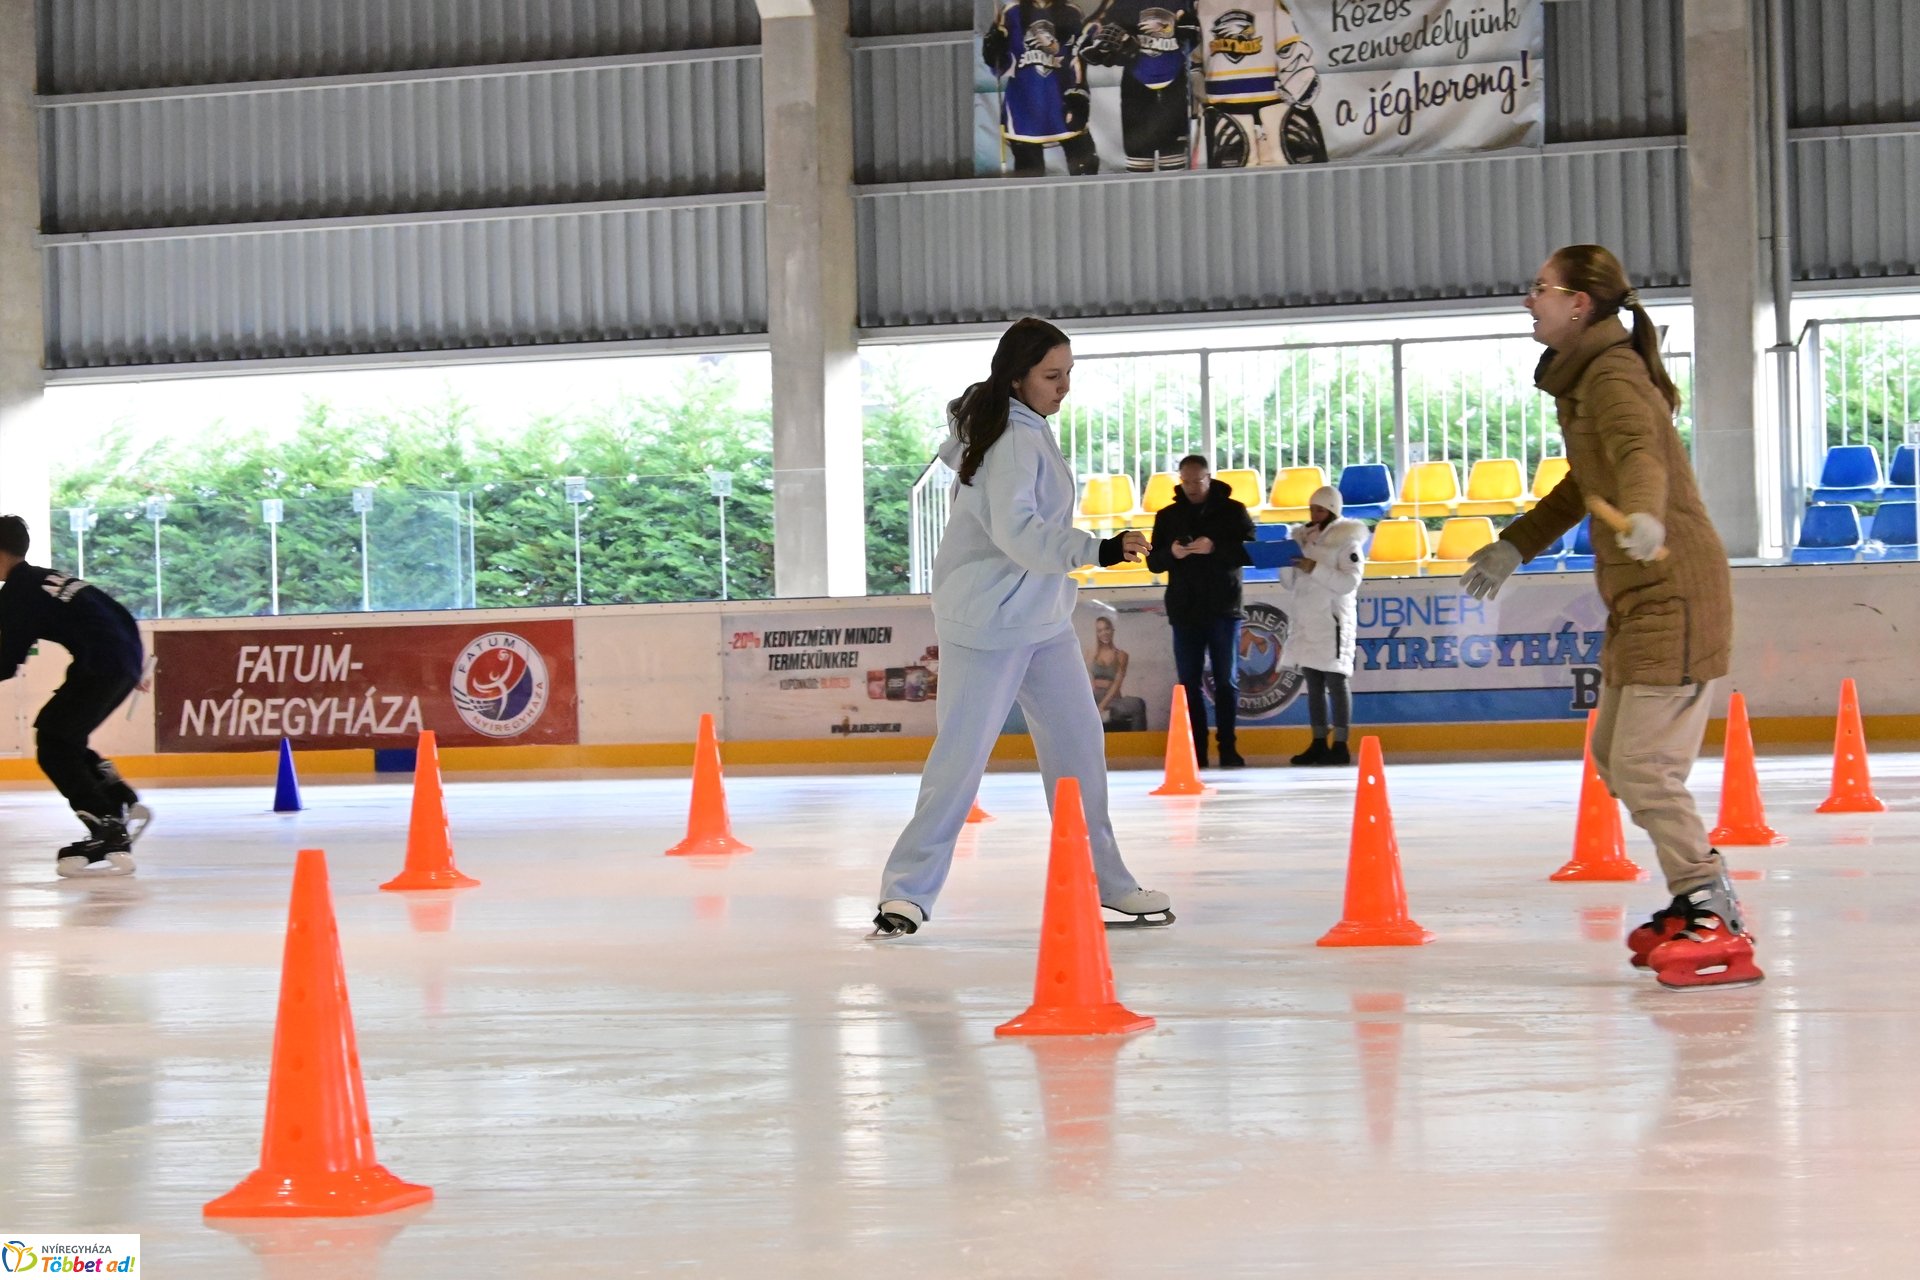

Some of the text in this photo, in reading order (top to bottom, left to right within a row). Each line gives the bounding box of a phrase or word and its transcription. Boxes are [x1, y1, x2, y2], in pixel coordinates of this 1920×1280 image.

[1328, 0, 1518, 67] szenvedélyünk
[1336, 50, 1531, 135] a jégkorong!
[458, 637, 516, 674] FATUM
[763, 625, 842, 648] KEDVEZMÉNY
[844, 626, 893, 645] MINDEN
[236, 643, 364, 683] FATUM-
[768, 650, 859, 671] TERMÉKÜNKRE!
[179, 686, 424, 736] NYÍREGYHÁZA
